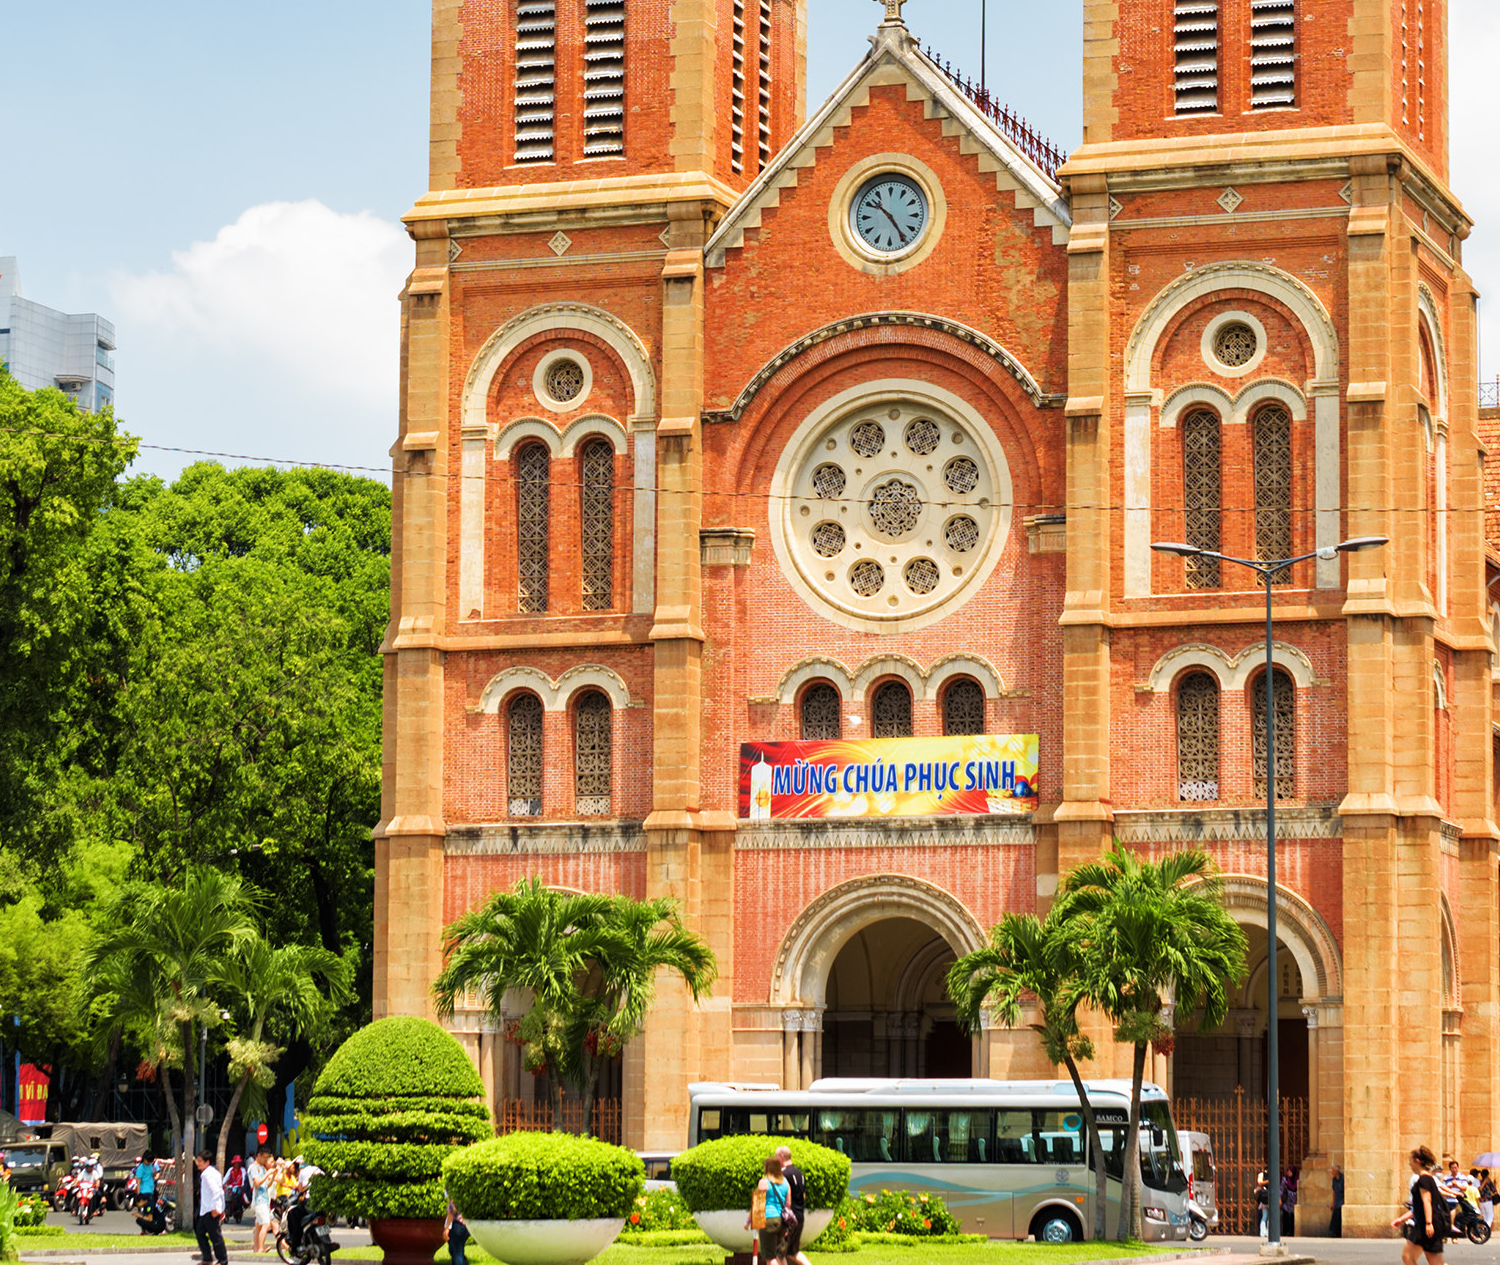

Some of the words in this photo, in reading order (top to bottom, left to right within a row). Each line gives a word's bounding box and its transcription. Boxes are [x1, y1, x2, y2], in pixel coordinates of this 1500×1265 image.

[773, 758, 838, 795] MỪNG
[842, 757, 898, 794] CHÚA
[904, 761, 960, 801] PHỤC
[964, 760, 1015, 791] SINH
[1095, 1114, 1123, 1122] SAMCO
